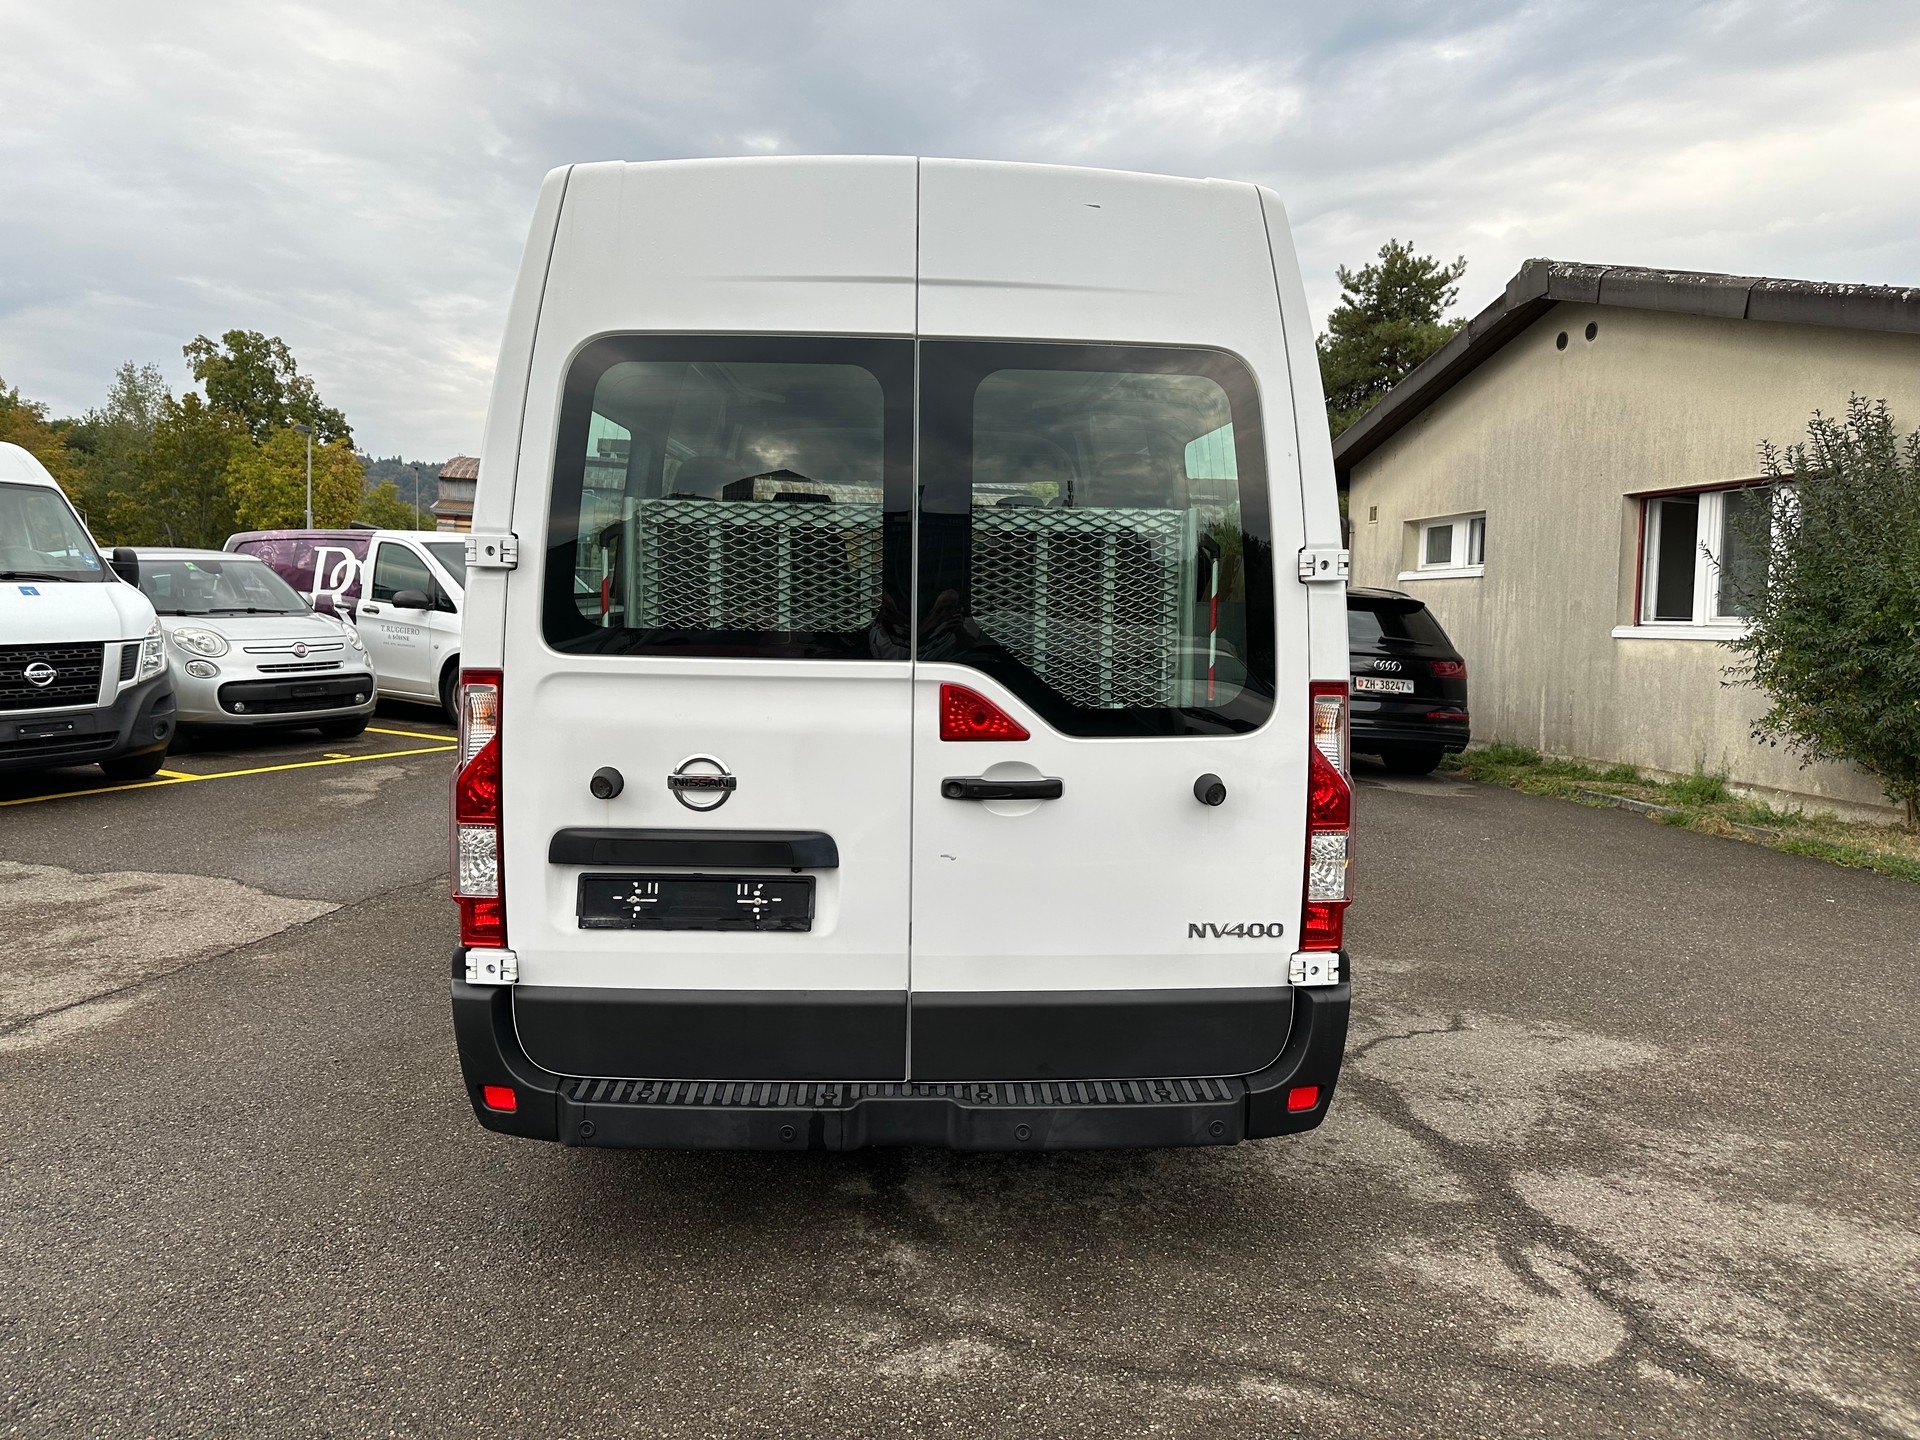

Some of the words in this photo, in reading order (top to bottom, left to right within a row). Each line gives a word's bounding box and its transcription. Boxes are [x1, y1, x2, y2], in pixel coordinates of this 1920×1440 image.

[386, 625, 420, 636] RUGGIERO
[673, 777, 729, 788] NISSAN
[1187, 922, 1284, 939] NV400
